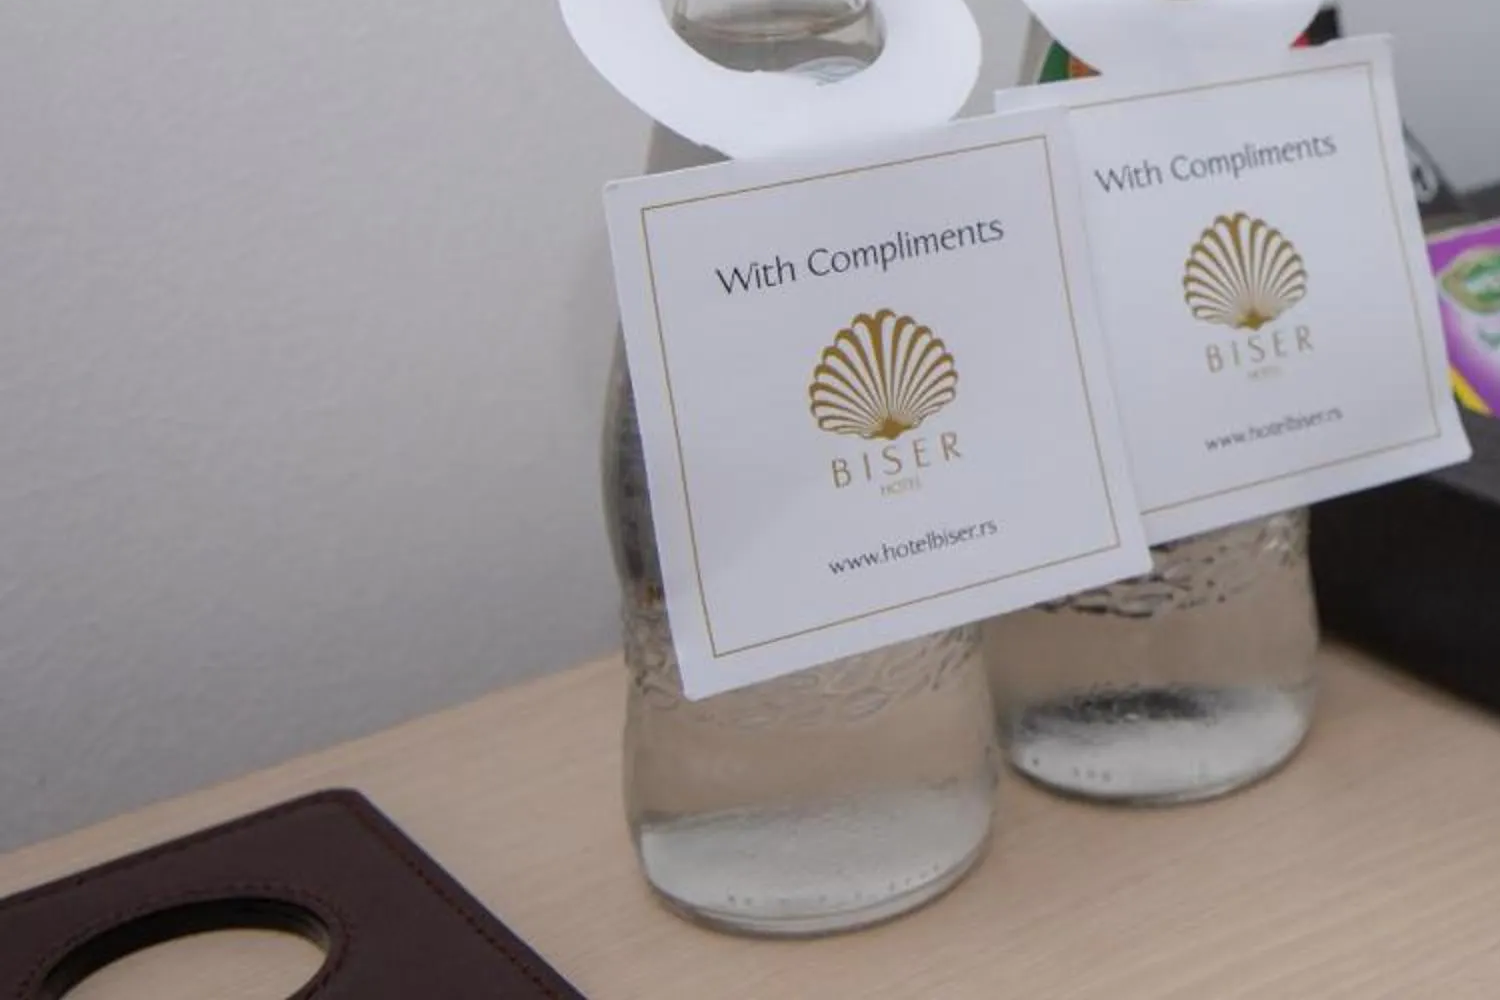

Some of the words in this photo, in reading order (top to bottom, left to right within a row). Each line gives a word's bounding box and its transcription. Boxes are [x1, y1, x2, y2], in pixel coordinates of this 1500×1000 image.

[1094, 159, 1163, 193] With
[1170, 134, 1337, 179] Compliments
[715, 255, 796, 295] With
[807, 218, 1004, 272] Compliments
[1205, 325, 1315, 374] BISER
[831, 431, 962, 489] BISER
[828, 519, 998, 574] www.hotelbiser.rs
